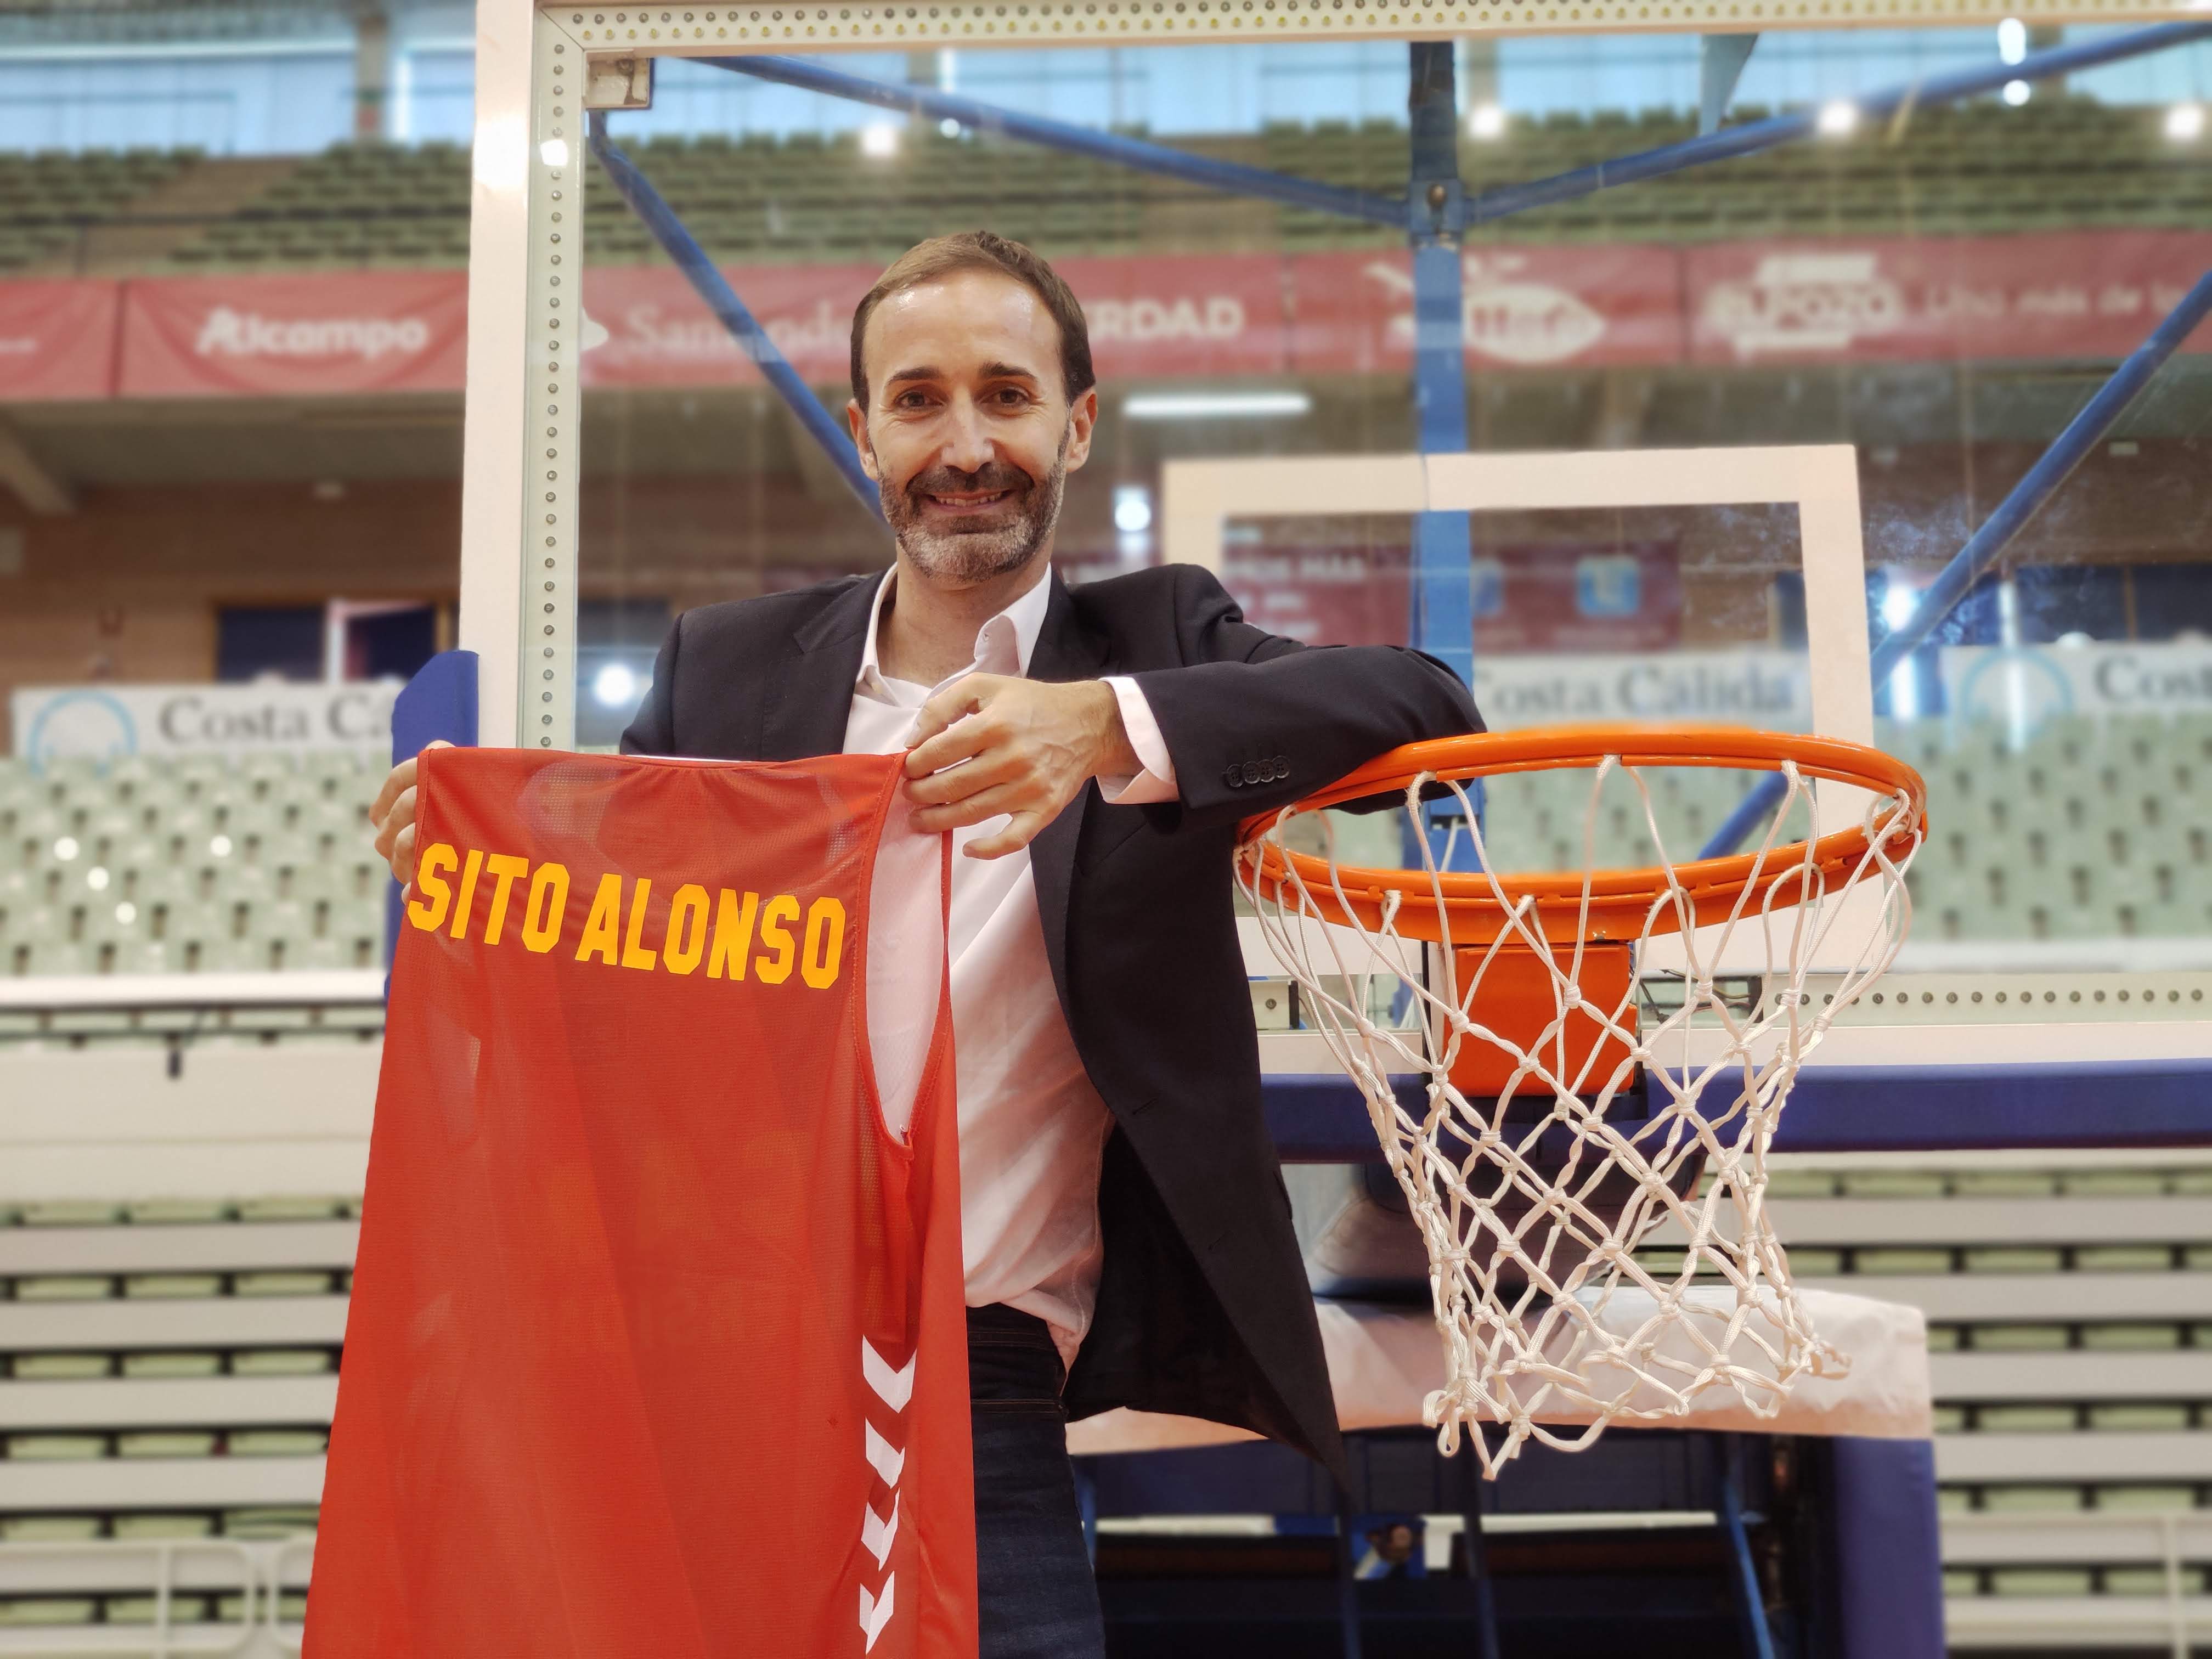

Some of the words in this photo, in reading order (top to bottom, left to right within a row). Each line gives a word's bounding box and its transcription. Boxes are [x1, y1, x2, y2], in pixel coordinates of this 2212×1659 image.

[195, 306, 428, 360] Alcampo
[157, 695, 311, 744] Costa
[407, 843, 571, 954] SITO
[575, 873, 847, 989] ALONSO
